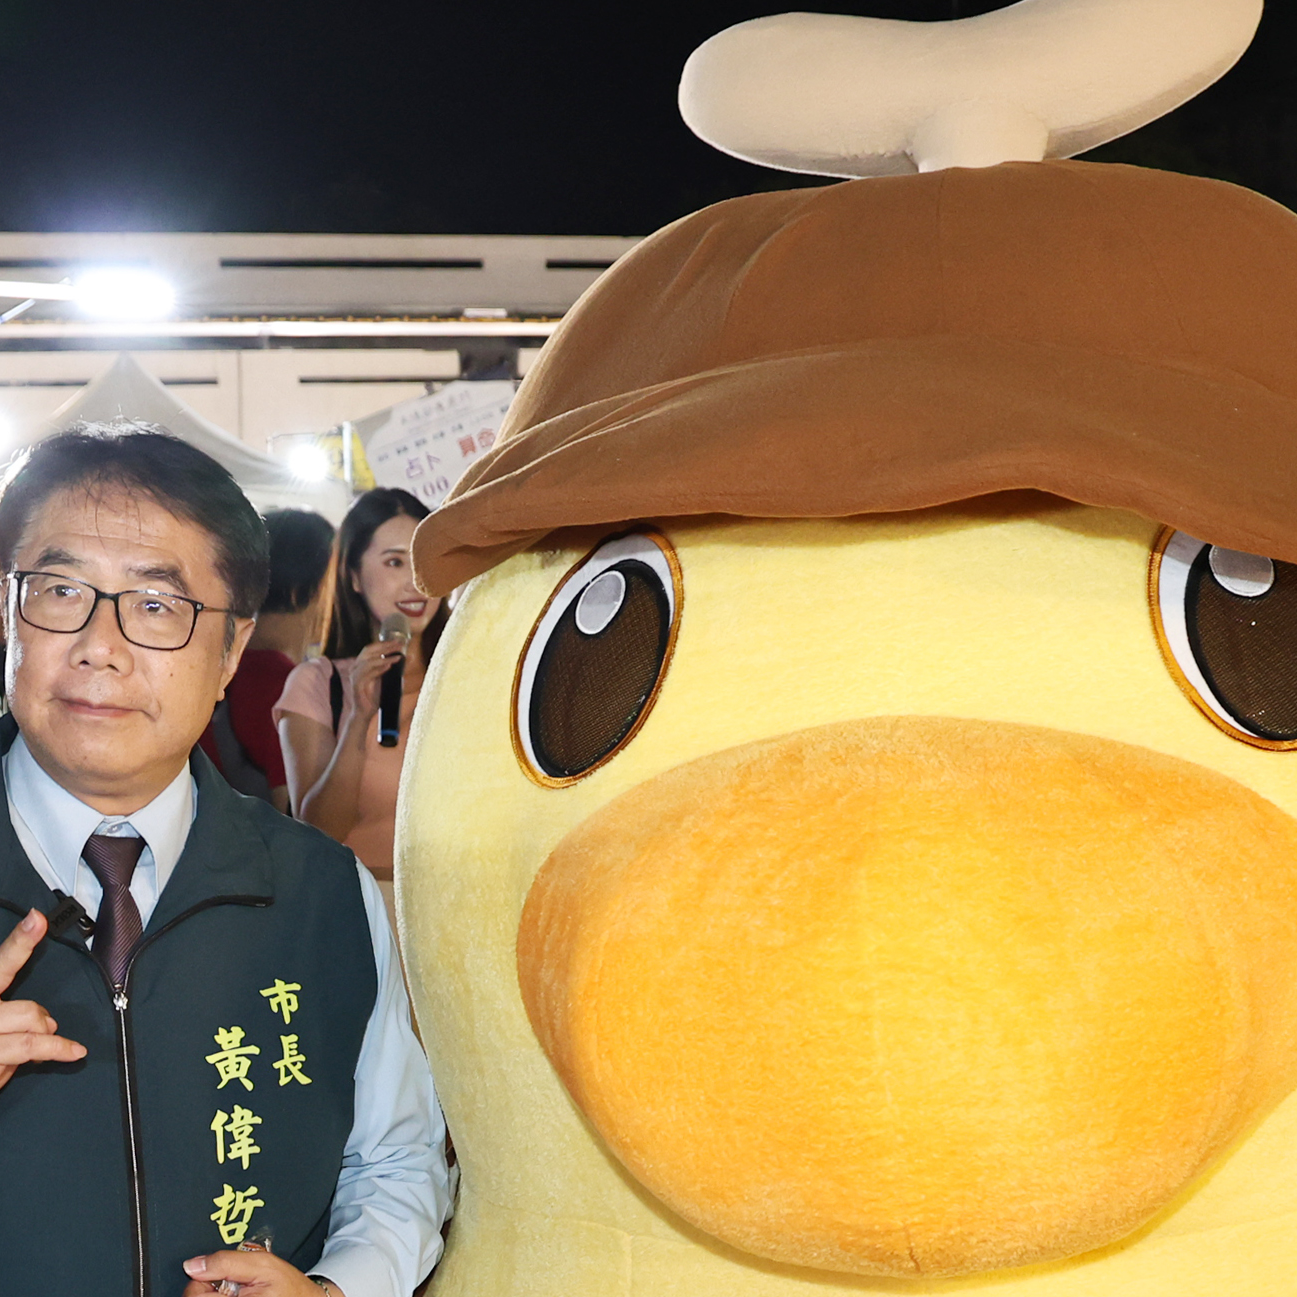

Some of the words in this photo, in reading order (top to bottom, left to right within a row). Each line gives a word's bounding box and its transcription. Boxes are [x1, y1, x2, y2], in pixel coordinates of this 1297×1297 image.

[259, 979, 312, 1086] 市長
[205, 1026, 265, 1245] 黃偉哲
